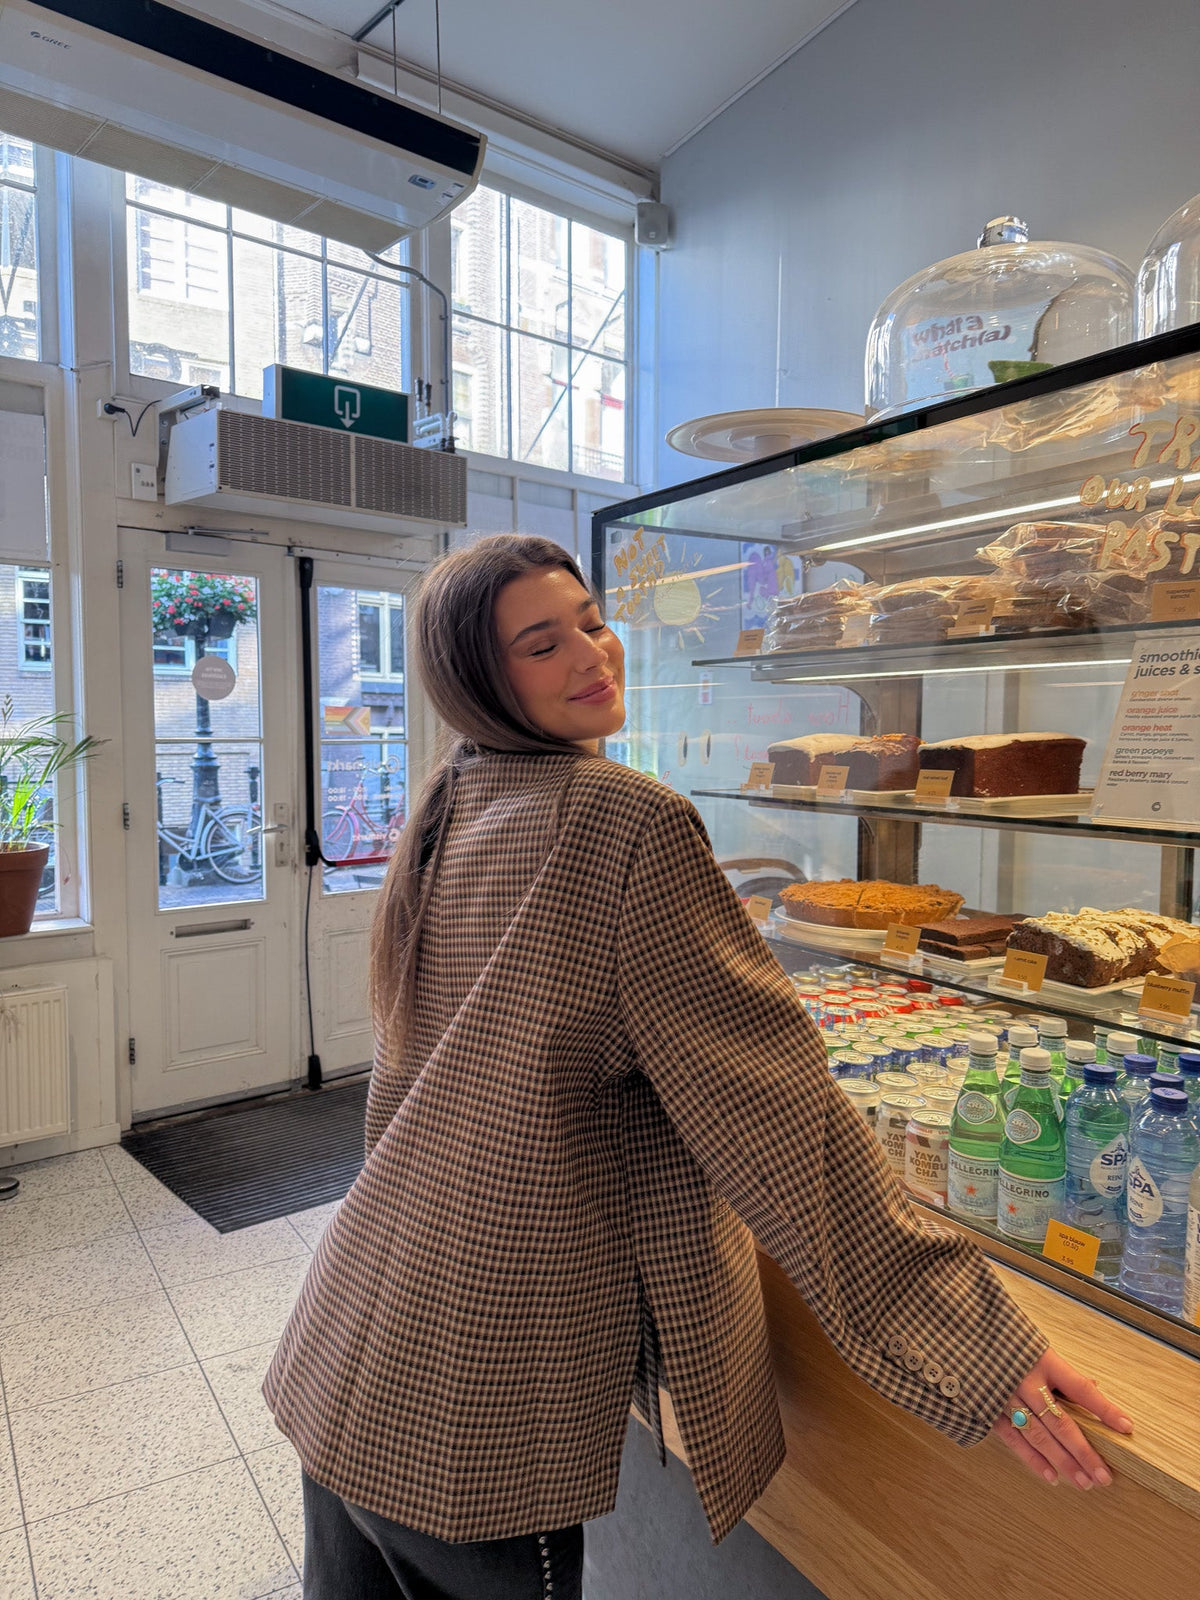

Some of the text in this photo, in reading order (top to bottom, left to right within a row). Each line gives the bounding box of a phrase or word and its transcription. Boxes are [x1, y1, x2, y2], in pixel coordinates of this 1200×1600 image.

[1128, 414, 1200, 472] TR
[1080, 475, 1151, 513] OUR
[613, 526, 645, 578] NOT
[1097, 520, 1200, 575] PAST
[628, 533, 666, 589] SWEET
[1138, 648, 1200, 664] smoothi
[1133, 664, 1176, 680] juices
[1179, 663, 1191, 676] &
[1126, 705, 1179, 715] orange juice
[1121, 723, 1173, 733] orange heat
[1115, 747, 1175, 756] green popeye
[1109, 769, 1173, 780] red berry mary
[881, 1138, 905, 1150] KOM
[886, 1131, 905, 1141] YAY
[910, 1155, 948, 1171] KOMBU
[914, 1150, 942, 1163] YAYA
[915, 1167, 939, 1179] CHA
[950, 1159, 999, 1177] PELLEGRIN
